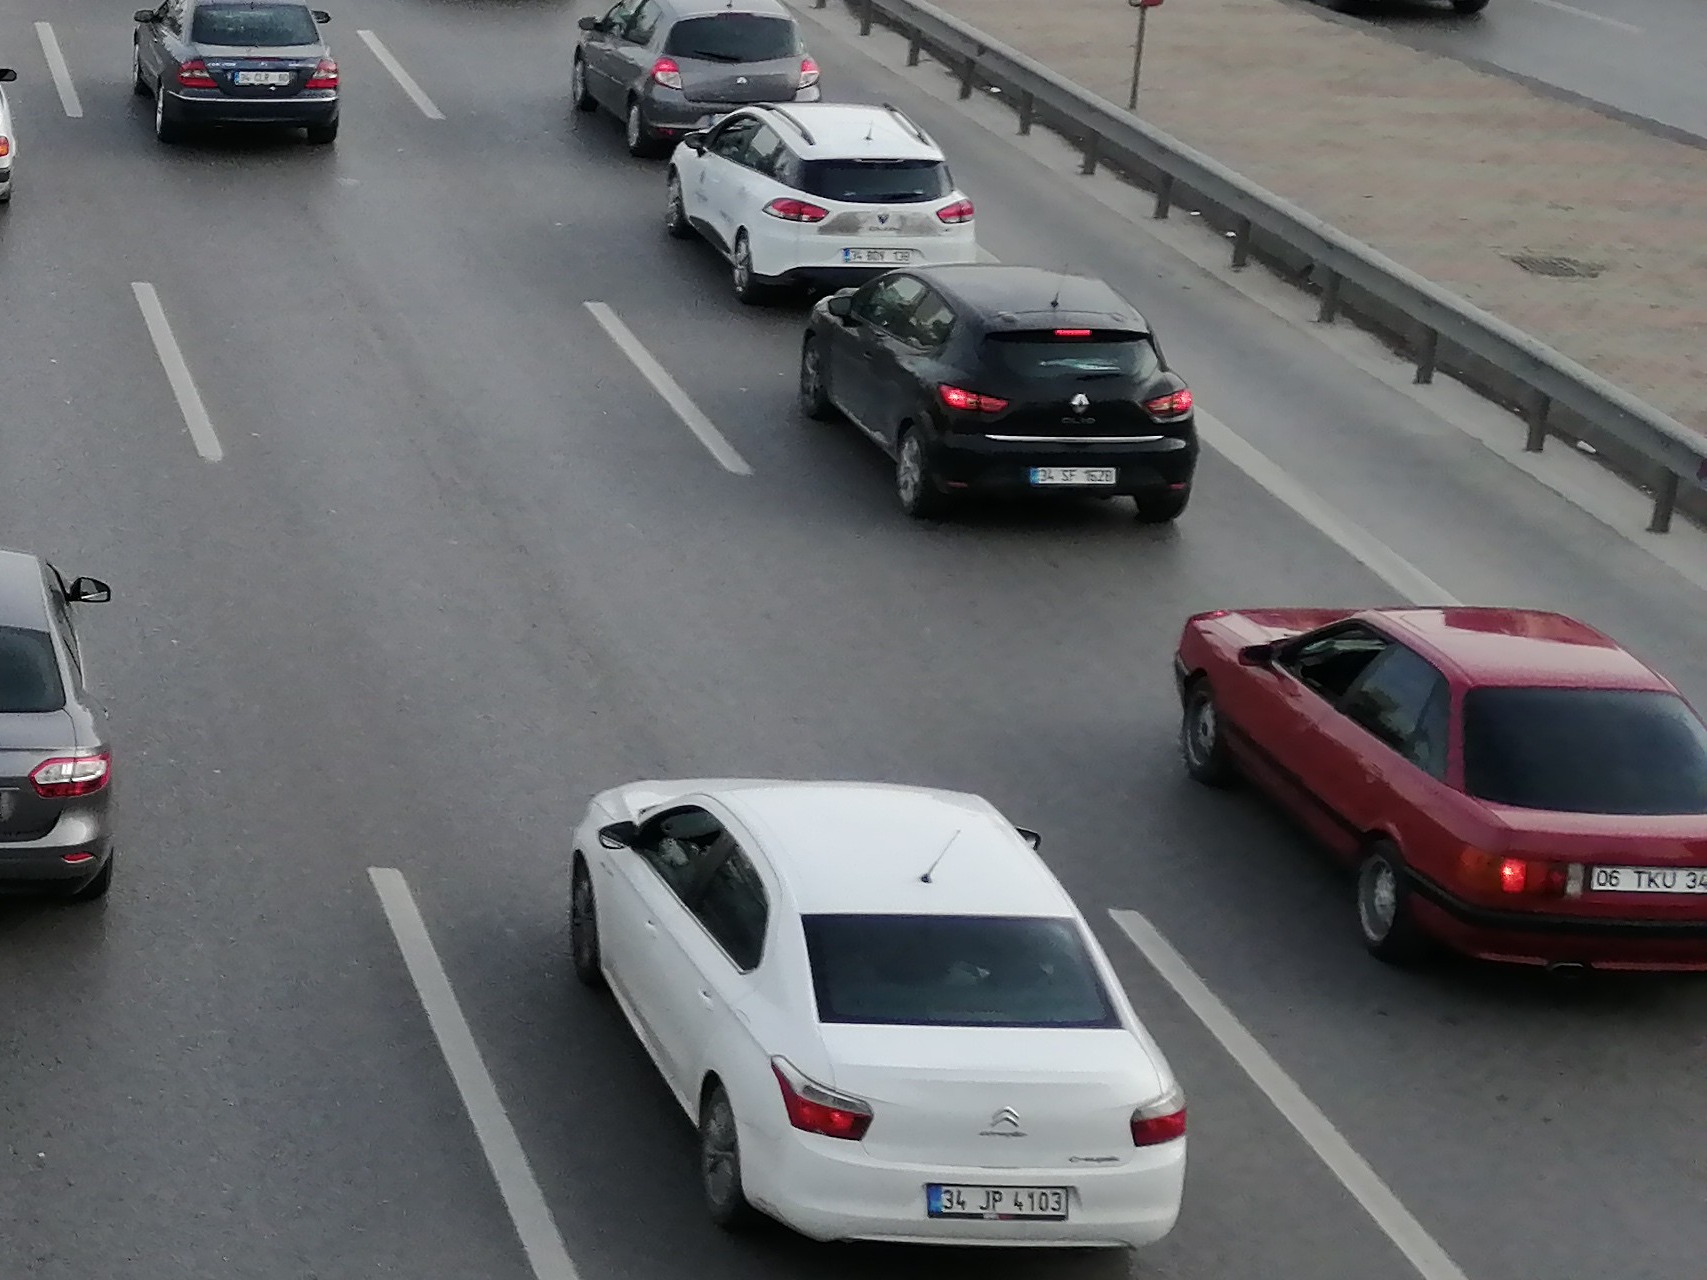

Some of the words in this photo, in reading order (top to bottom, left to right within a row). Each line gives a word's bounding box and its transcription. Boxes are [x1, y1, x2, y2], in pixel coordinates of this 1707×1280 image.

[1040, 469, 1054, 482] 34
[1596, 870, 1620, 887] 06
[1633, 871, 1677, 888] TKU
[942, 1190, 967, 1211] 34
[978, 1190, 1003, 1211] JP
[1013, 1191, 1063, 1212] 4103
